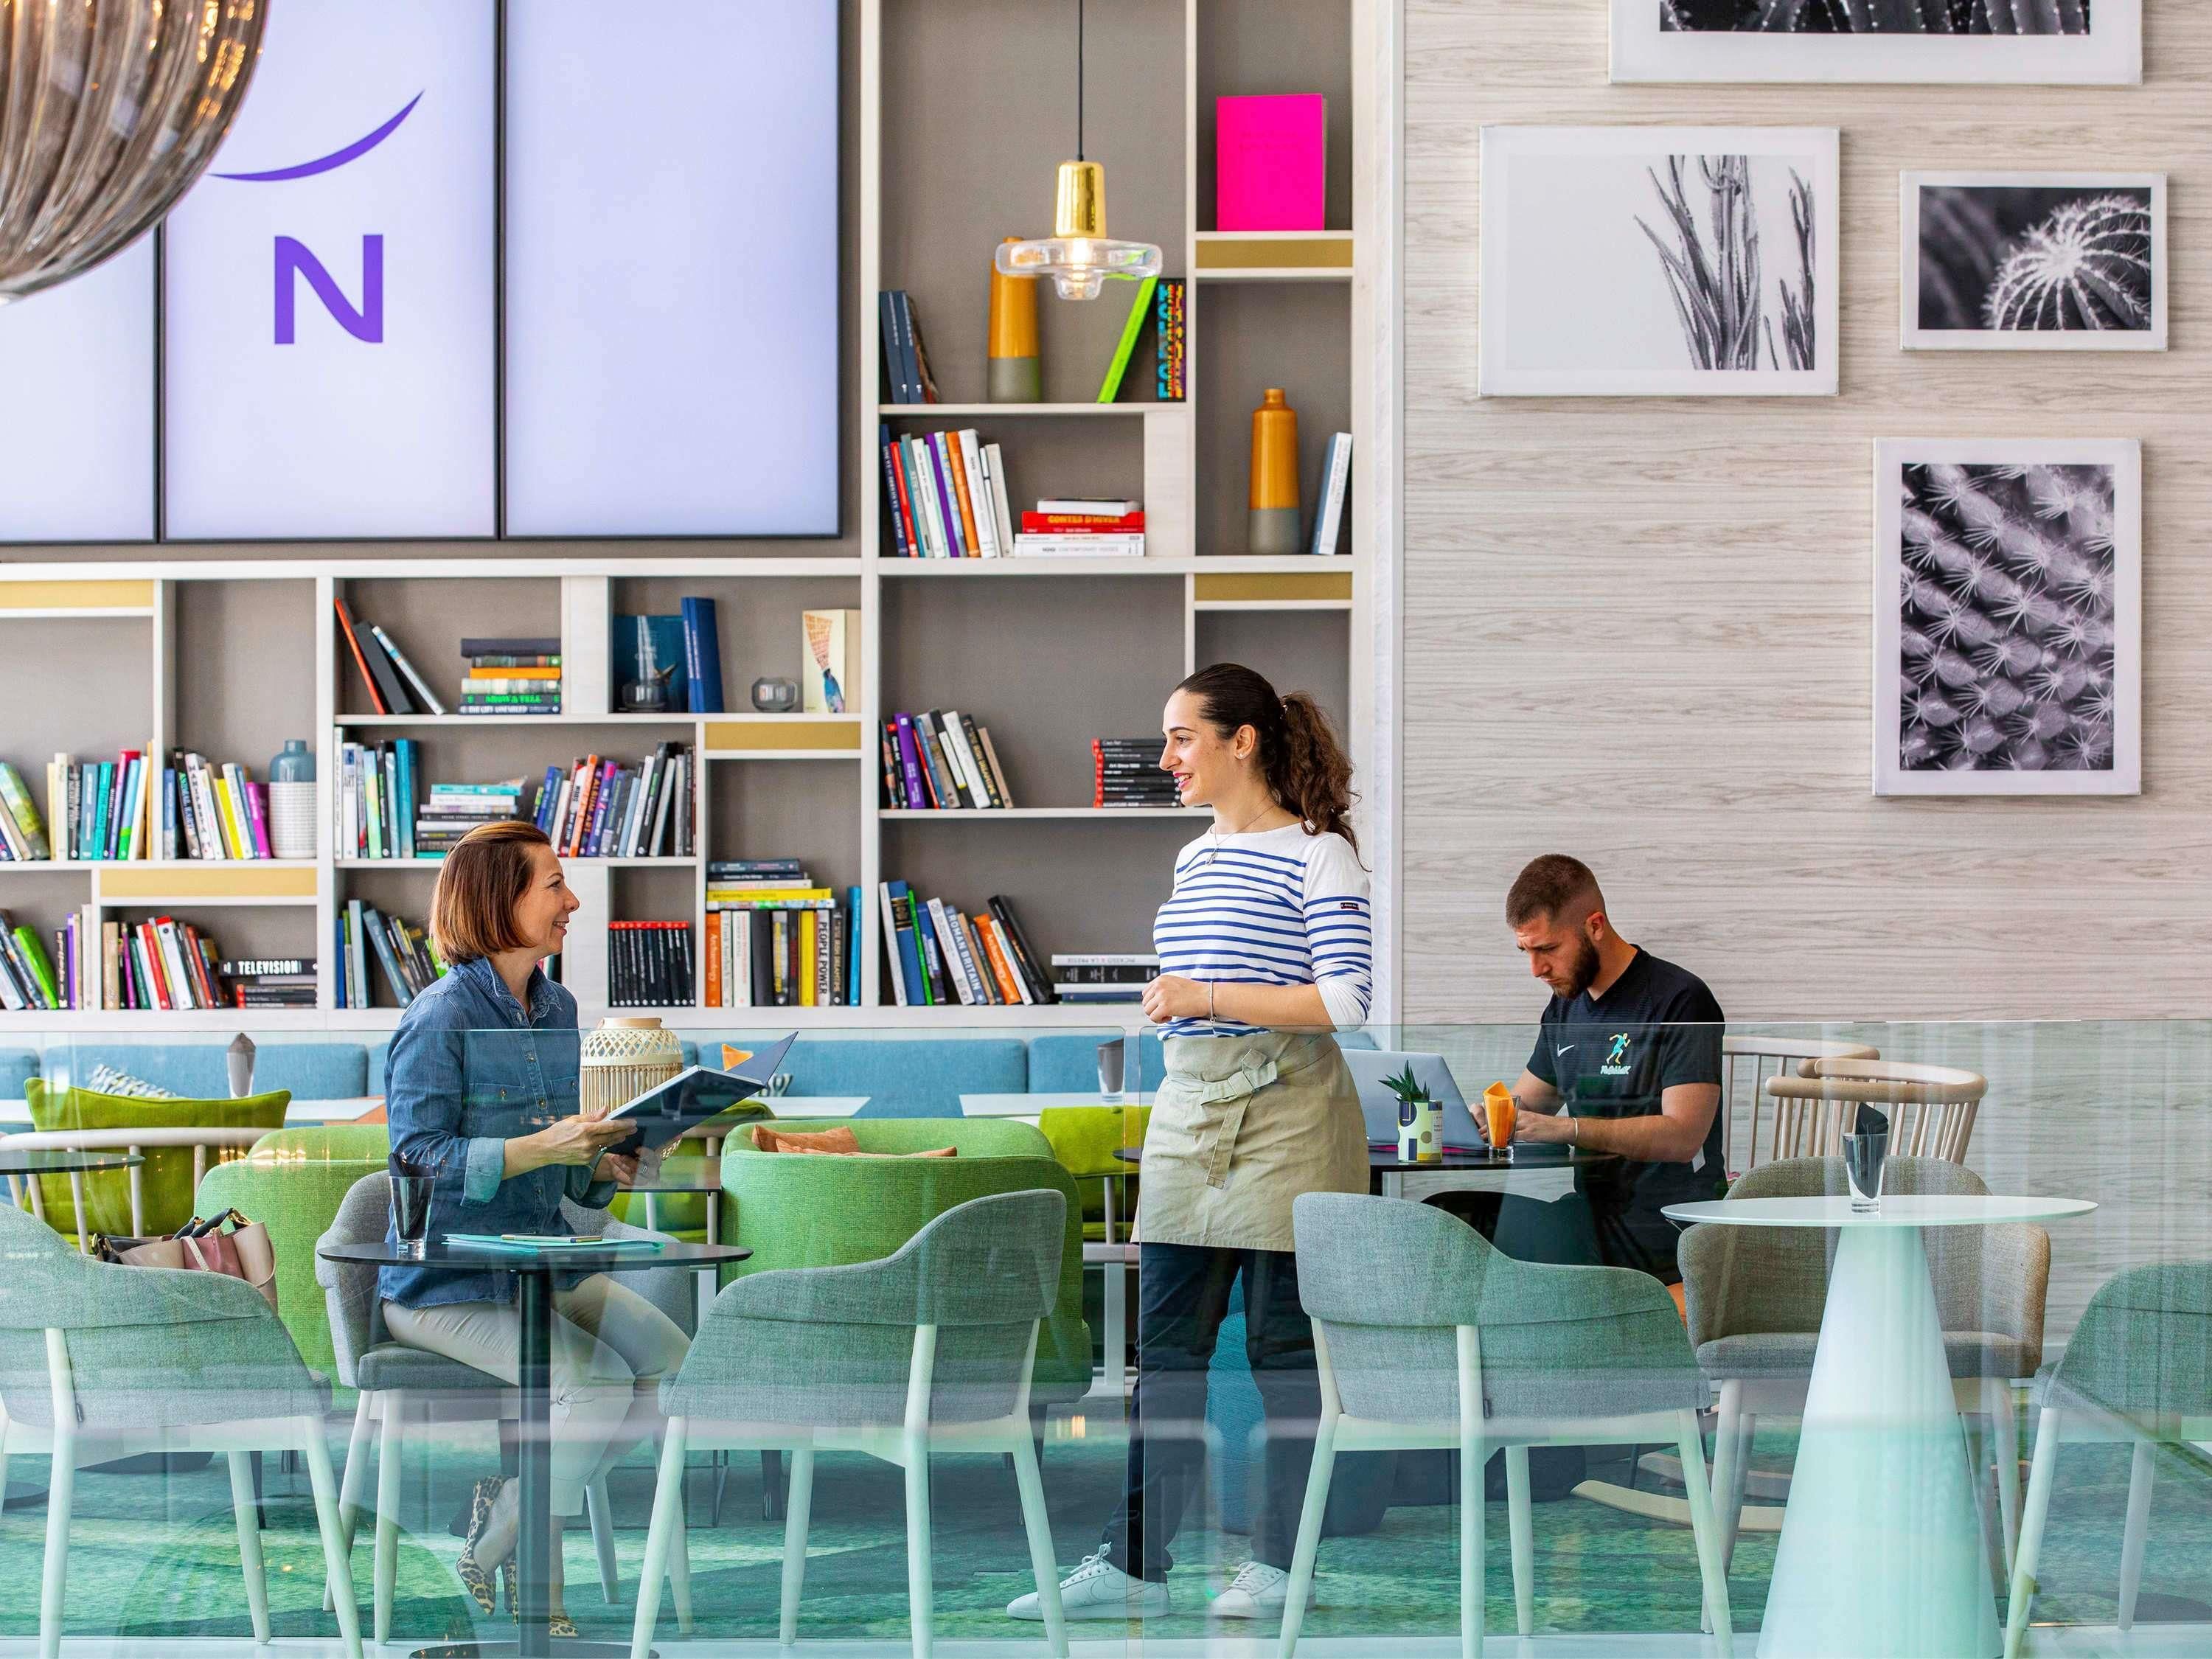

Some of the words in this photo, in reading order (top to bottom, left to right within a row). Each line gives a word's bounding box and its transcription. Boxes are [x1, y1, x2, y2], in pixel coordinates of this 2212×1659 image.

[275, 234, 383, 344] N
[707, 933, 718, 982] Archaeology
[818, 921, 827, 957] PEOPLE
[948, 914, 966, 948] ROMAN
[960, 950, 981, 990] BRITAIN
[985, 933, 1006, 981] Archaeology
[238, 960, 299, 975] TELEVISION
[818, 960, 827, 994] POWER
